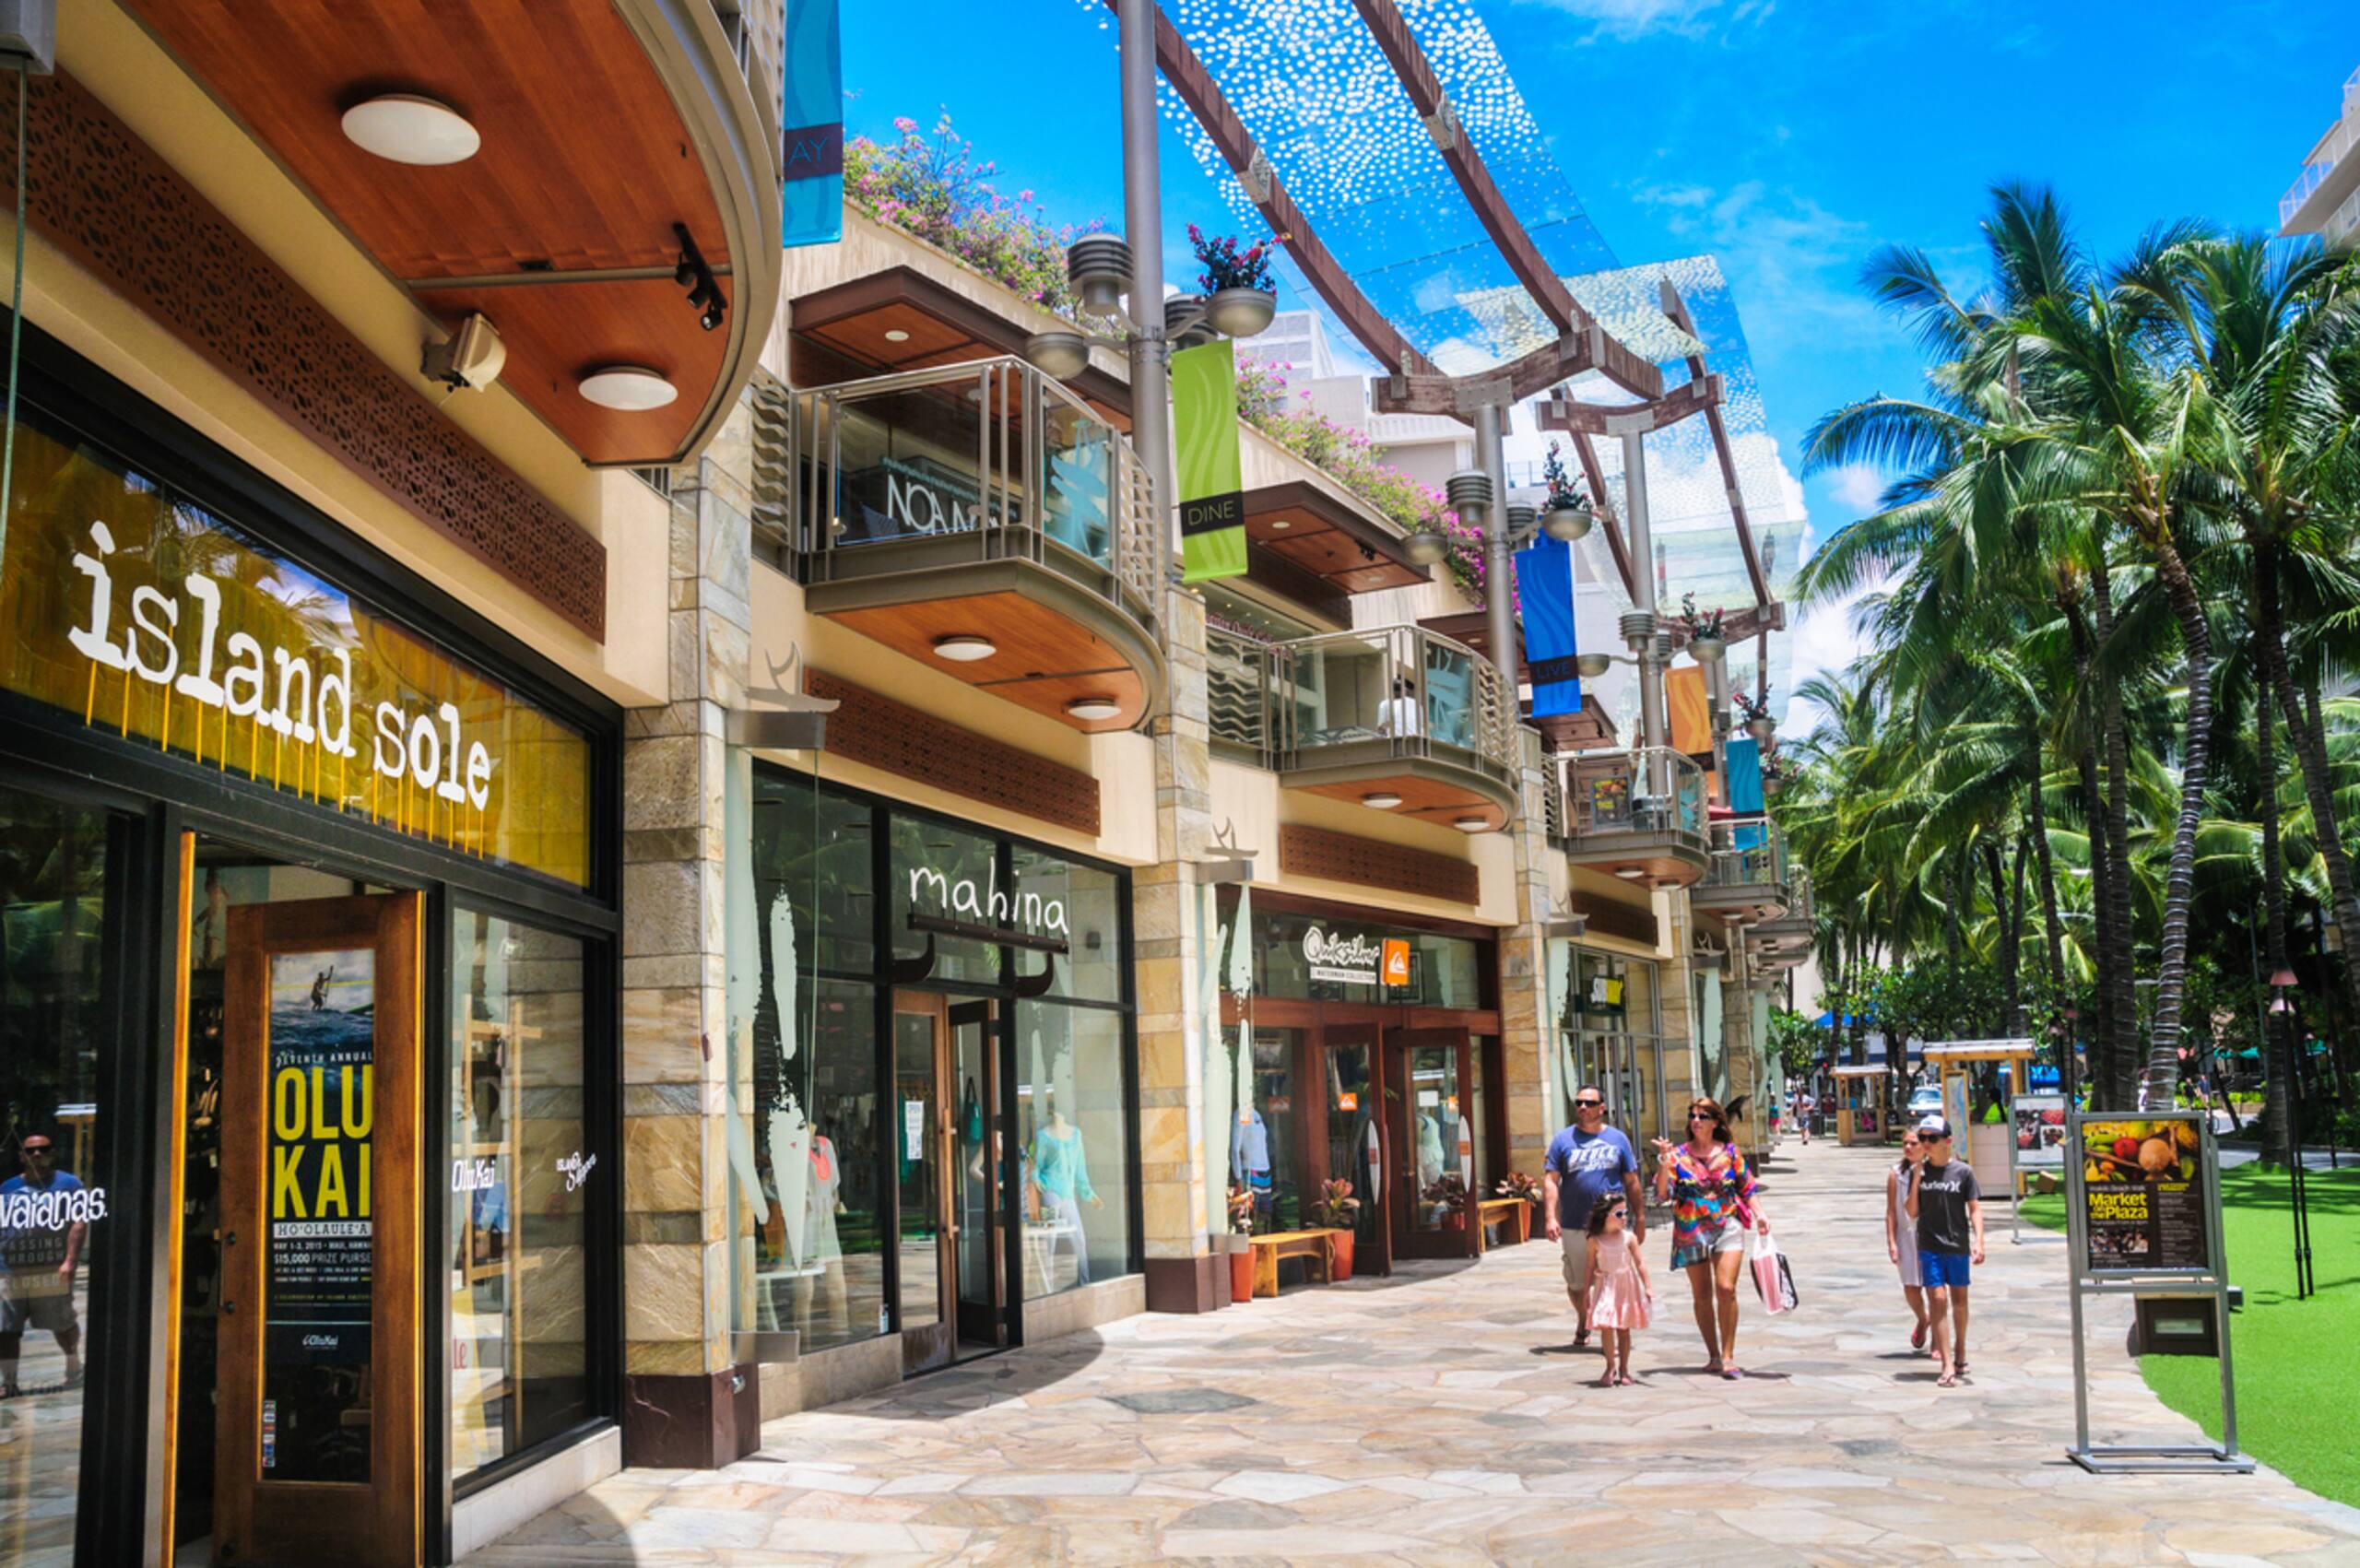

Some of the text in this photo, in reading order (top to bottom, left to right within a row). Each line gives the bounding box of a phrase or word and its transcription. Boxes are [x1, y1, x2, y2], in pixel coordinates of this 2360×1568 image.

[788, 136, 829, 164] AY
[888, 474, 950, 536] NOA
[1187, 500, 1235, 526] DINE
[67, 520, 491, 811] island sole
[1536, 661, 1572, 679] LIVE
[909, 855, 1069, 935] mahina
[330, 1051, 373, 1062] ANNUAL
[274, 1064, 373, 1141] OLU
[274, 1142, 372, 1219] KAI
[452, 1158, 496, 1192] OluKai
[2089, 1192, 2147, 1207] Market
[2106, 1206, 2149, 1220] Plaza
[7, 1237, 64, 1251] ASSING
[8, 1252, 65, 1264] HROUGH
[312, 1253, 338, 1264] PRIZE
